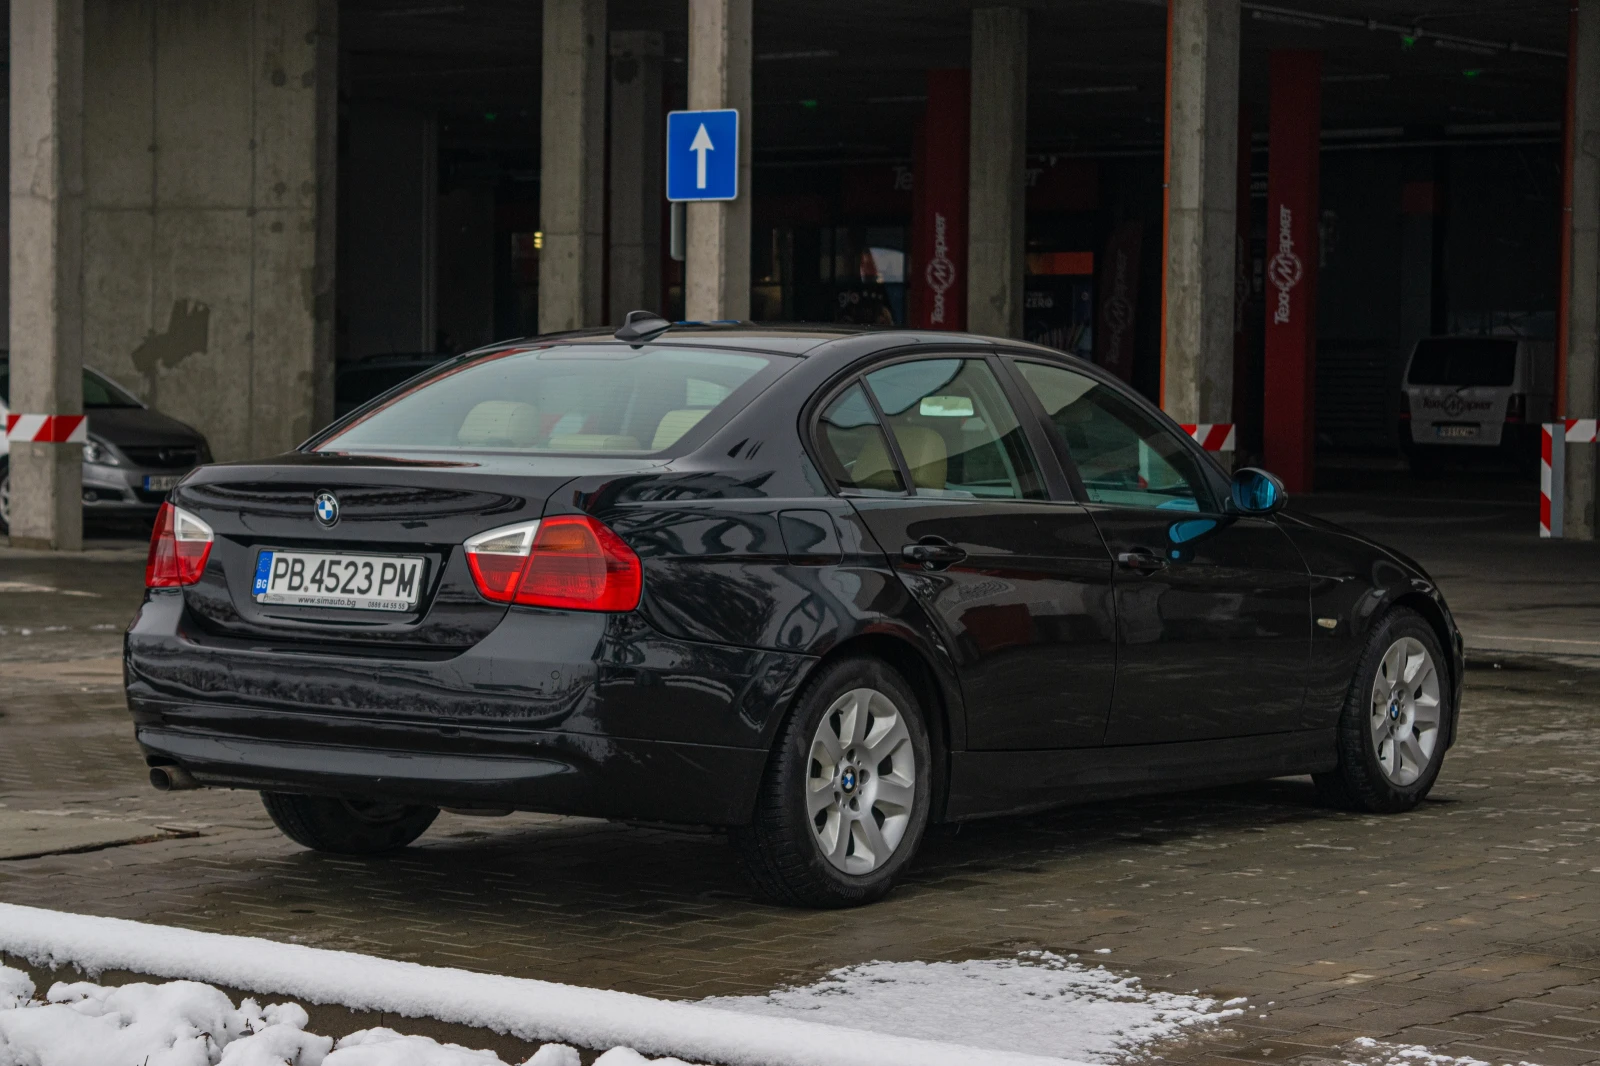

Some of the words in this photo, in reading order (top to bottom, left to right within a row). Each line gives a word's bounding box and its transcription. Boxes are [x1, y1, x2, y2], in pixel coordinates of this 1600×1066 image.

[256, 579, 267, 589] BG
[377, 562, 417, 598] PM
[298, 596, 356, 608] www.simauto.bg
